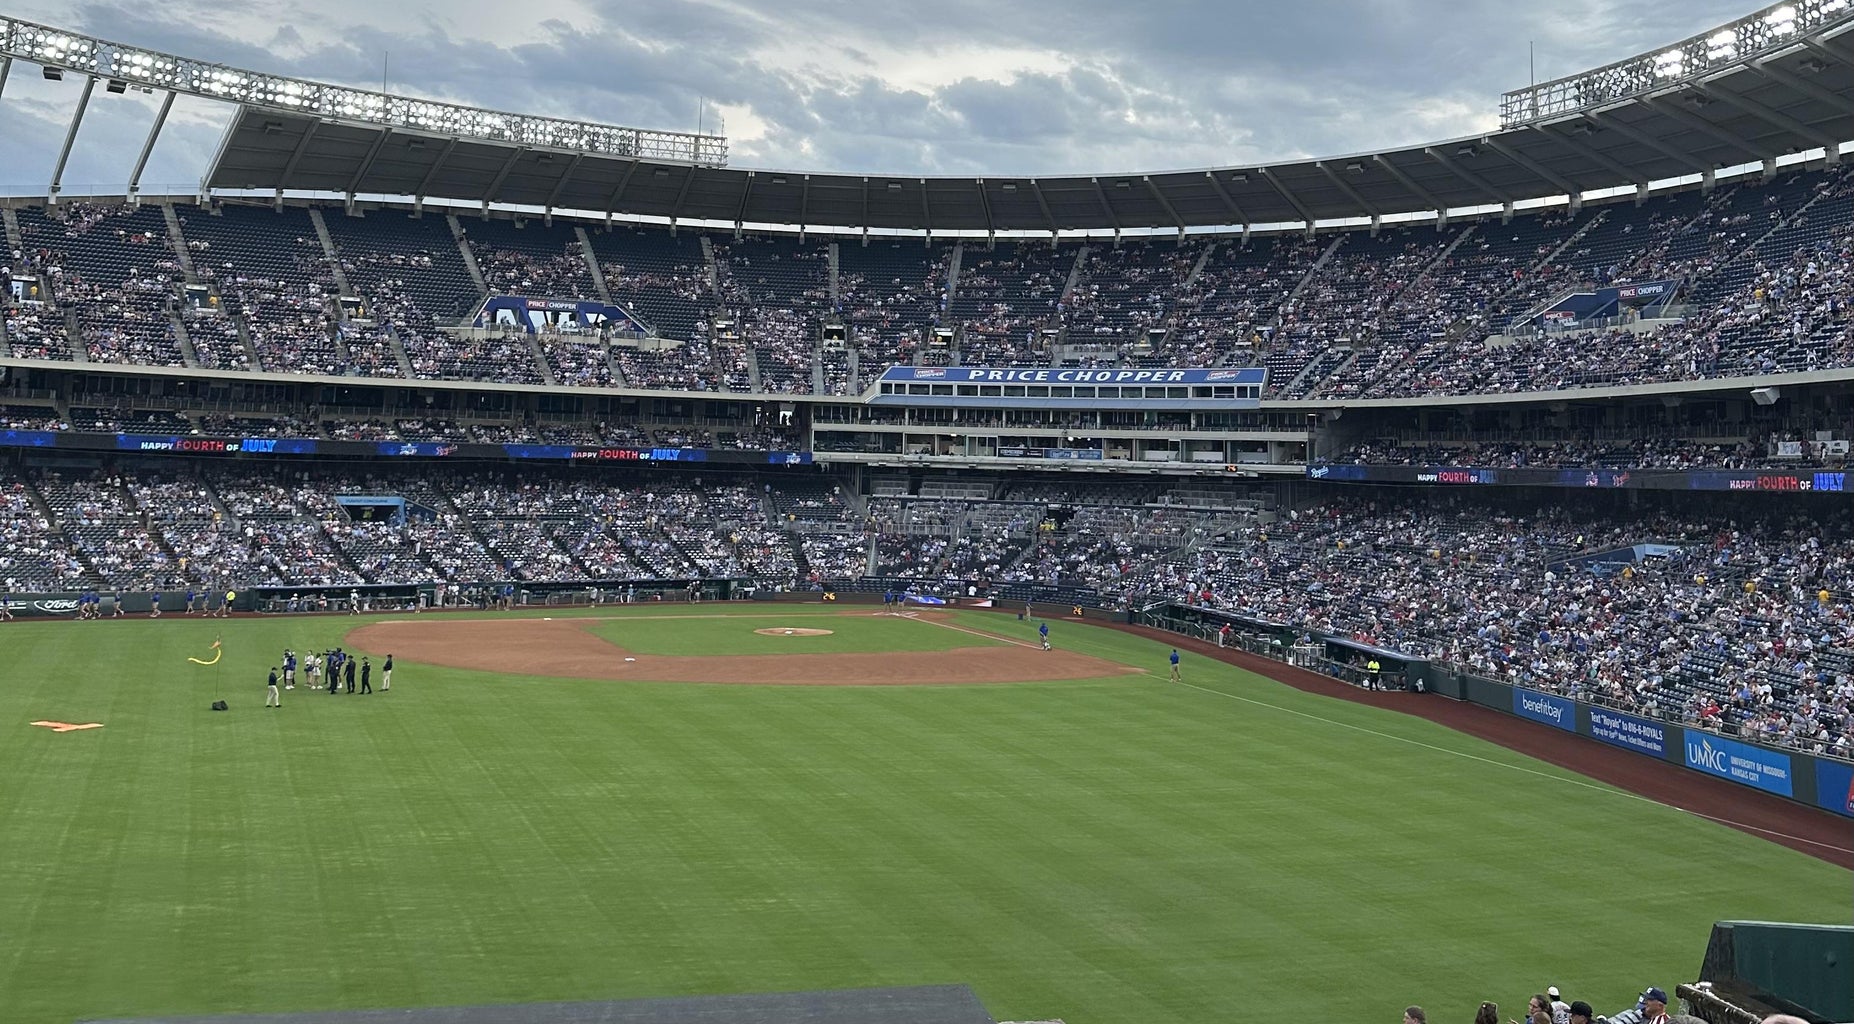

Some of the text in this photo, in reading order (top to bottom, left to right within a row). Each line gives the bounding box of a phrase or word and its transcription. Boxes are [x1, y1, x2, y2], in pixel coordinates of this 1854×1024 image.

[1620, 286, 1663, 297] PRICE CHOPPER
[528, 300, 577, 310] PRICE CHOPPER
[968, 369, 1186, 381] PRICE CHOPPER
[141, 442, 173, 450] HAPPY
[176, 440, 224, 451] FOURTH
[241, 439, 277, 452] JULY
[599, 449, 639, 459] FOURTH
[651, 448, 680, 461] JULY
[1418, 474, 1437, 482] HAPPY
[1438, 471, 1470, 483] FOURTH
[1470, 475, 1478, 483] OF
[1730, 472, 1846, 491] HAPPY FOURTH OF JULY
[44, 600, 79, 609] Ford
[1522, 693, 1562, 723] benefitbay
[1590, 712, 1601, 723] Text
[1601, 714, 1621, 729] "Royals"
[1621, 721, 1628, 731] to
[1688, 742, 1727, 773] UMKC
[1730, 756, 1756, 771] UNIVERSITY
[1756, 762, 1762, 773] OF
[1731, 767, 1759, 782] KANSAS CITY
